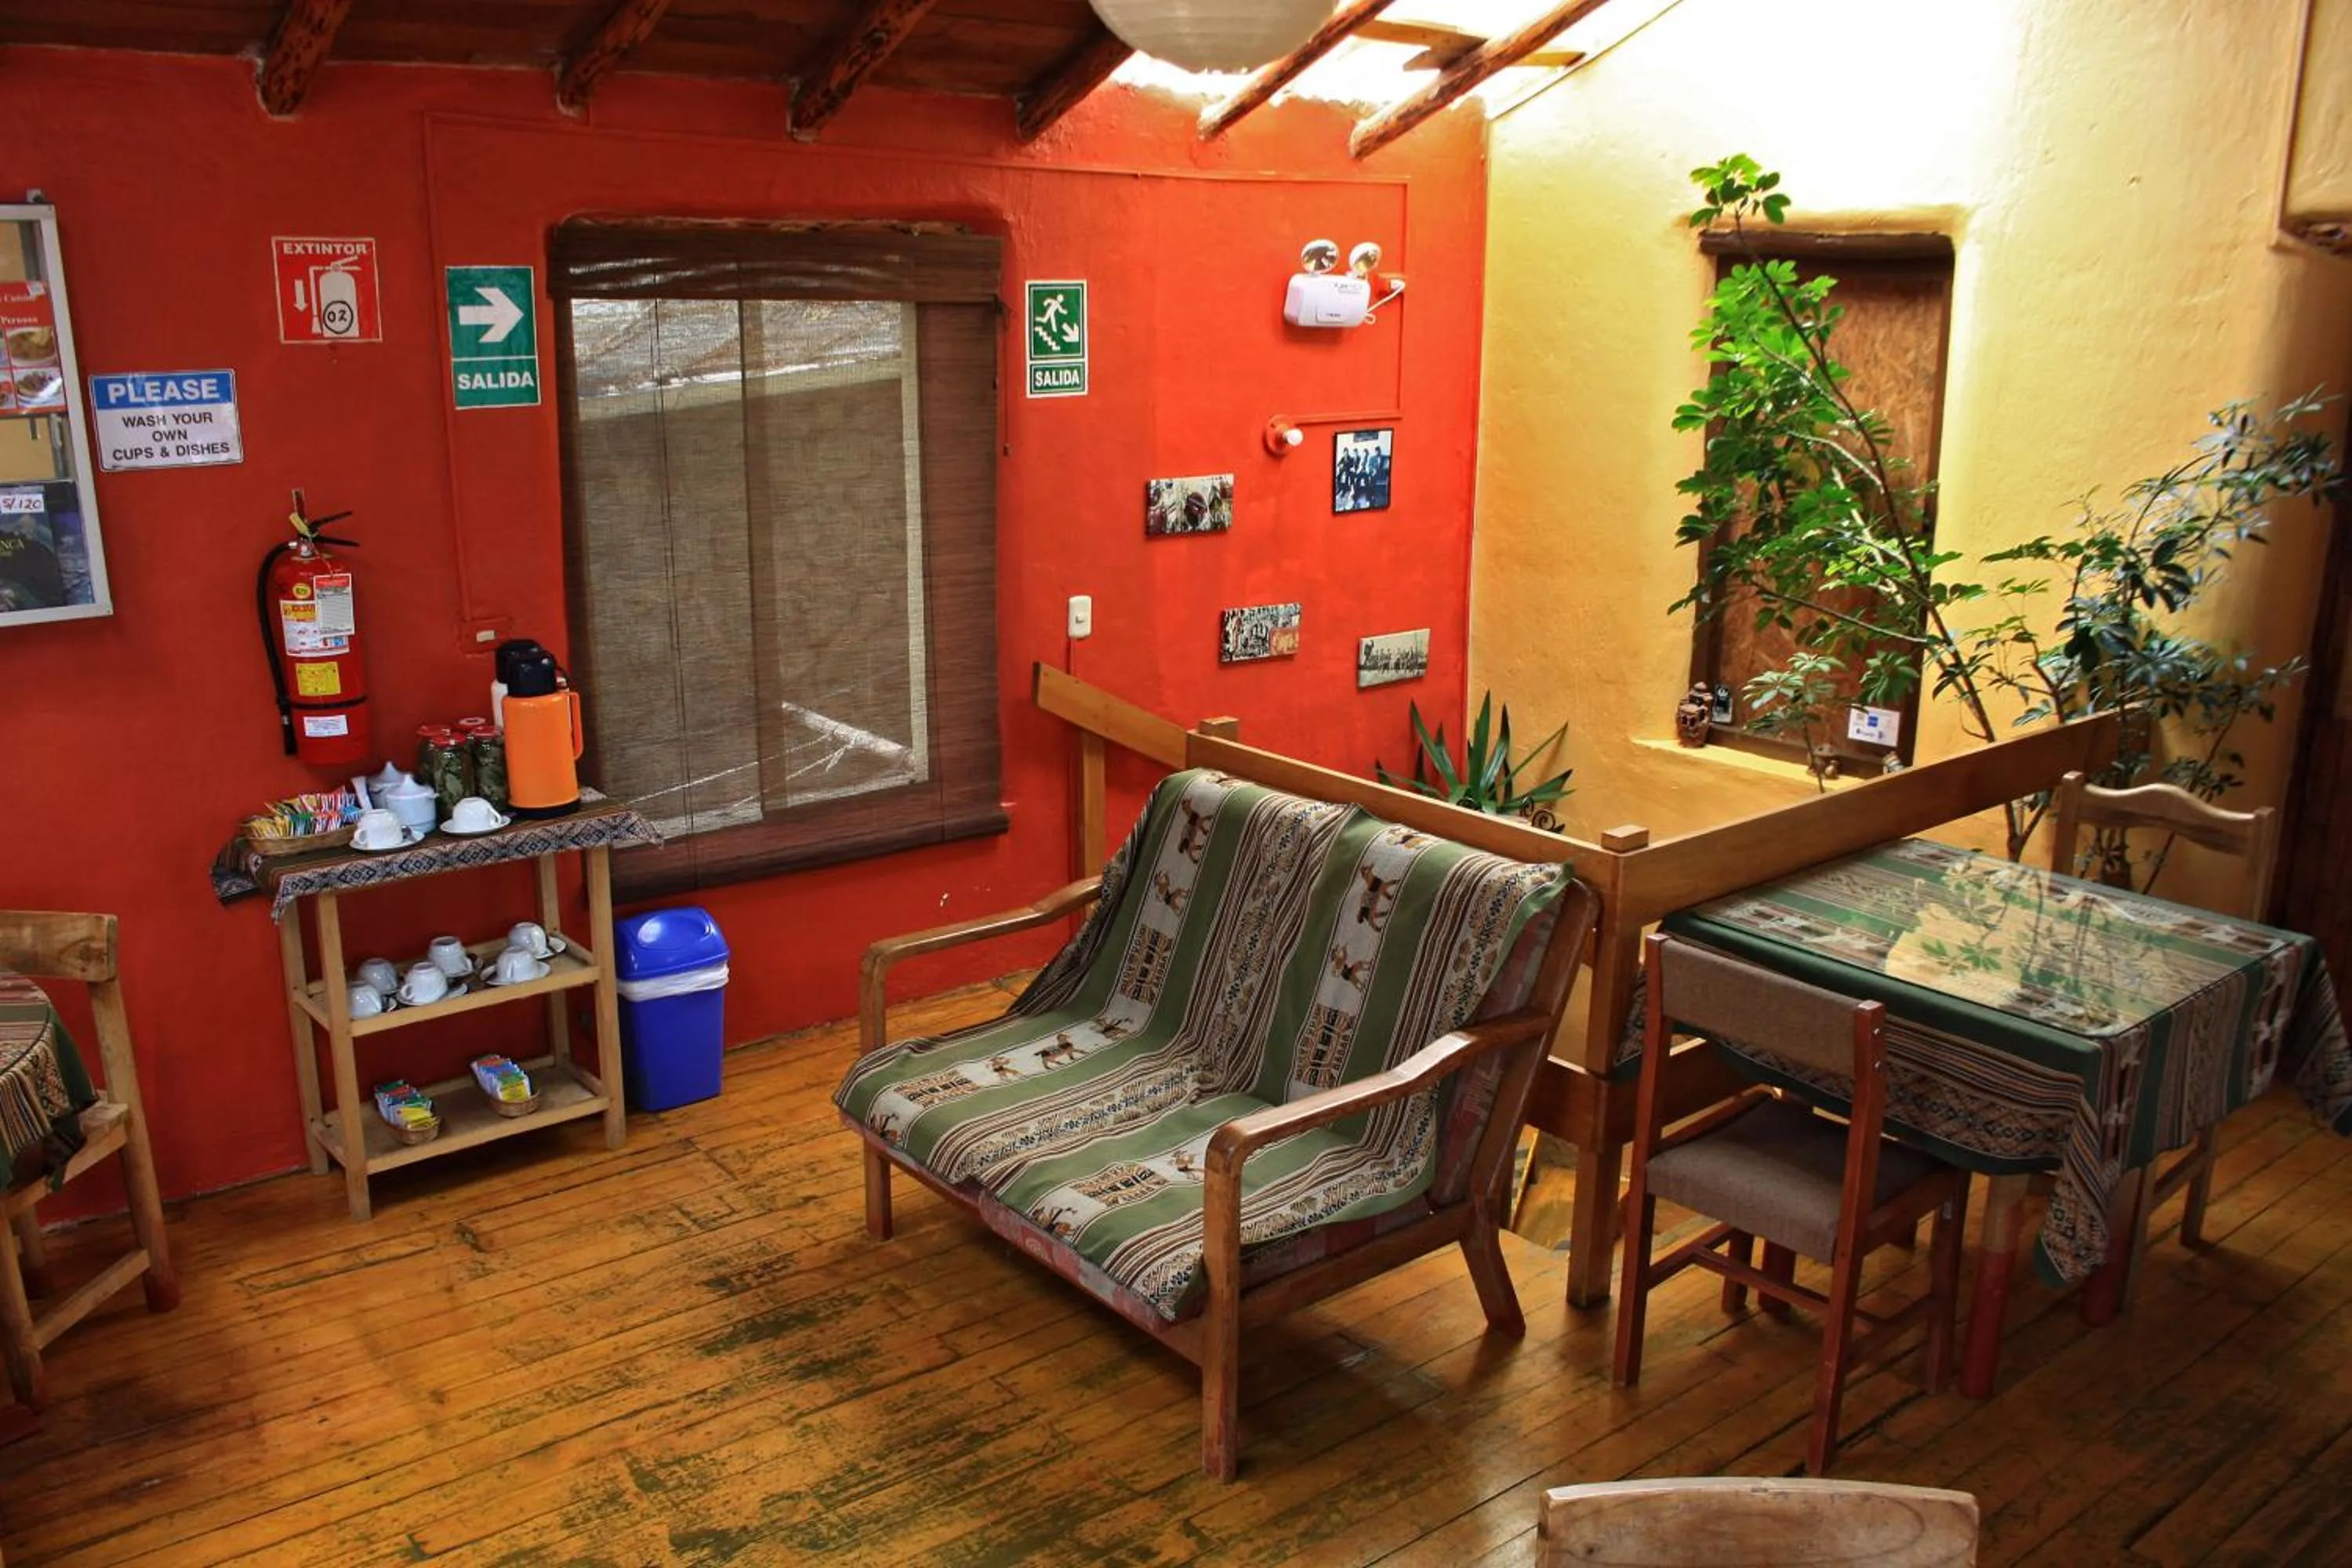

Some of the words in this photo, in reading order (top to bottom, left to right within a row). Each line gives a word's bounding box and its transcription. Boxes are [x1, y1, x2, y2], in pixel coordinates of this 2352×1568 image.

[283, 242, 367, 255] EXTINTOR
[327, 309, 347, 323] 02
[457, 372, 535, 390] SALIDA
[1035, 369, 1080, 387] SALIDA
[107, 378, 220, 405] PLEASE
[122, 415, 166, 428] WASH
[172, 412, 212, 425] YOUR
[152, 429, 187, 442] OWN
[113, 447, 154, 461] CUPS
[160, 446, 170, 458] &
[176, 442, 230, 456] DISHES
